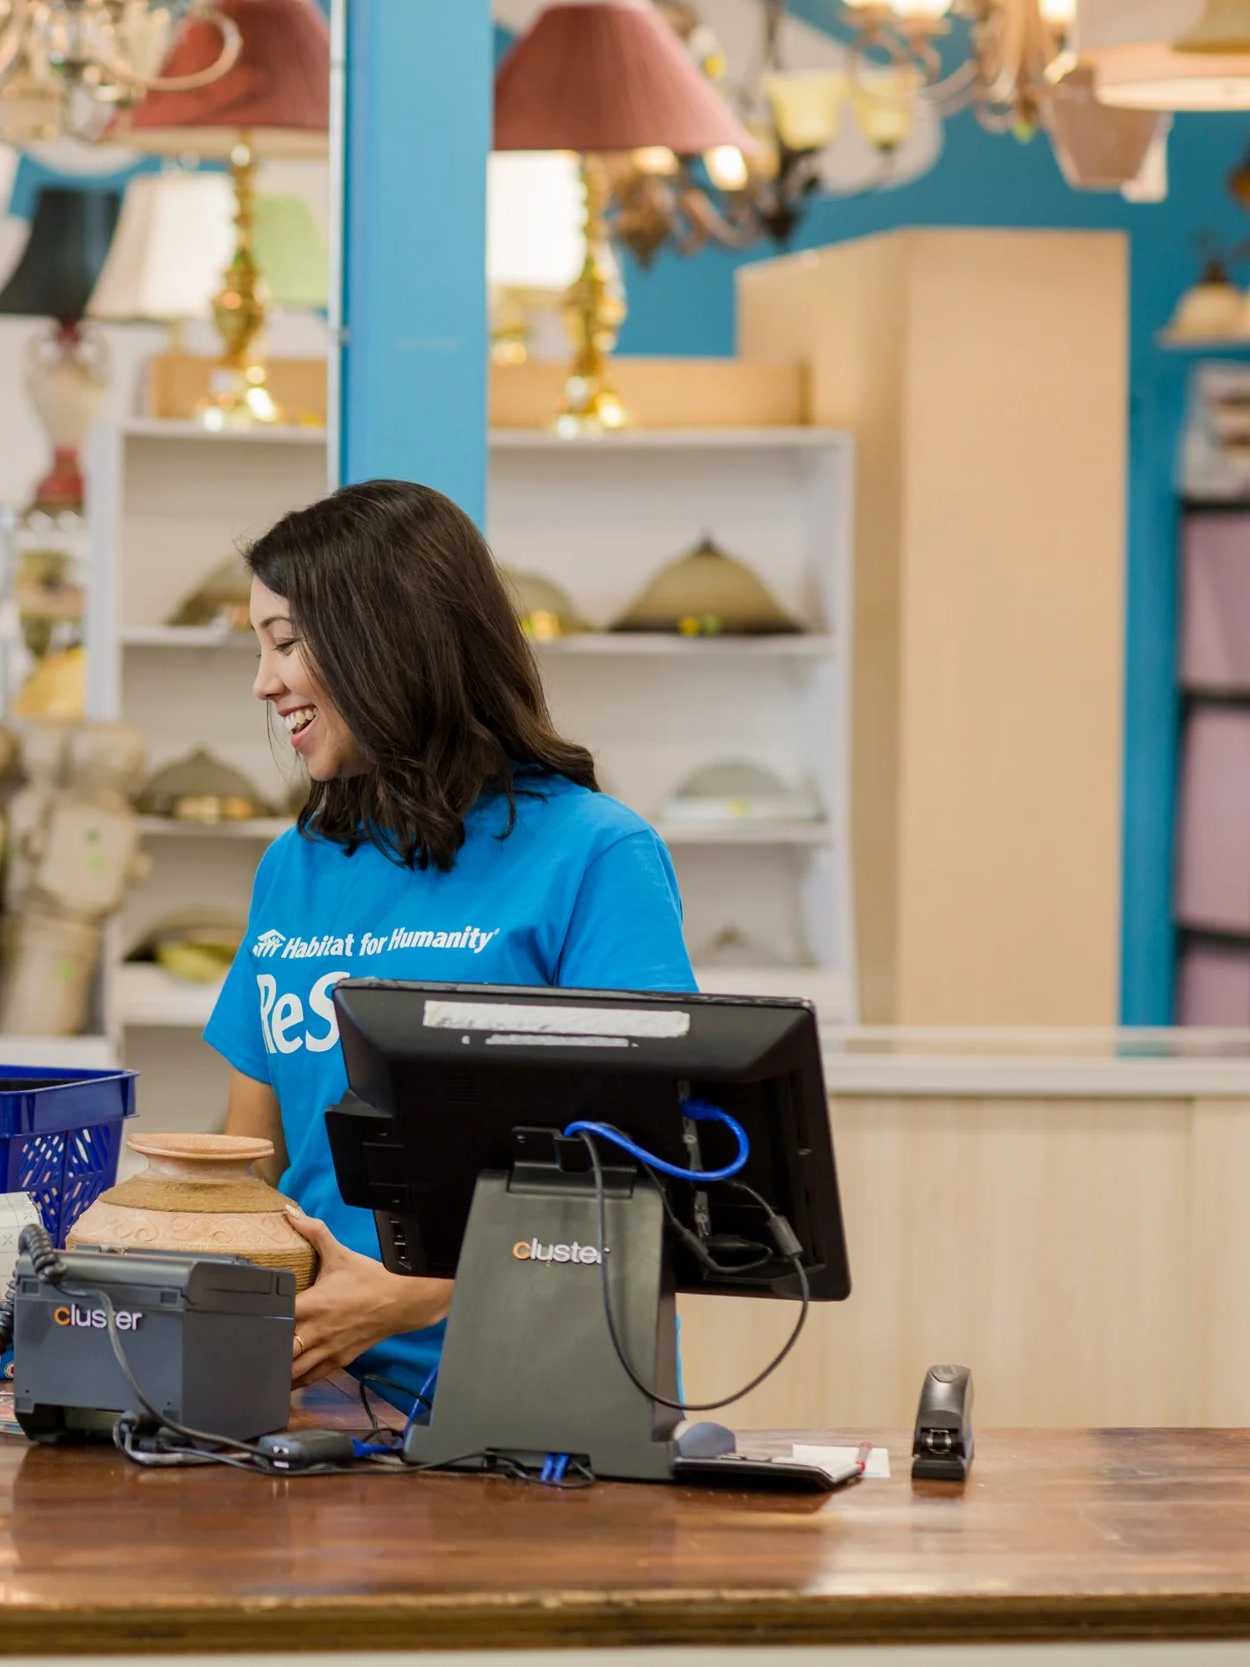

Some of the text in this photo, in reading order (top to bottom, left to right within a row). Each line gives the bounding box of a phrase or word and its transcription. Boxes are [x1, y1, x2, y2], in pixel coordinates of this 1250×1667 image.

[281, 925, 494, 959] Habitat for Humanity
[54, 1303, 143, 1330] cluser
